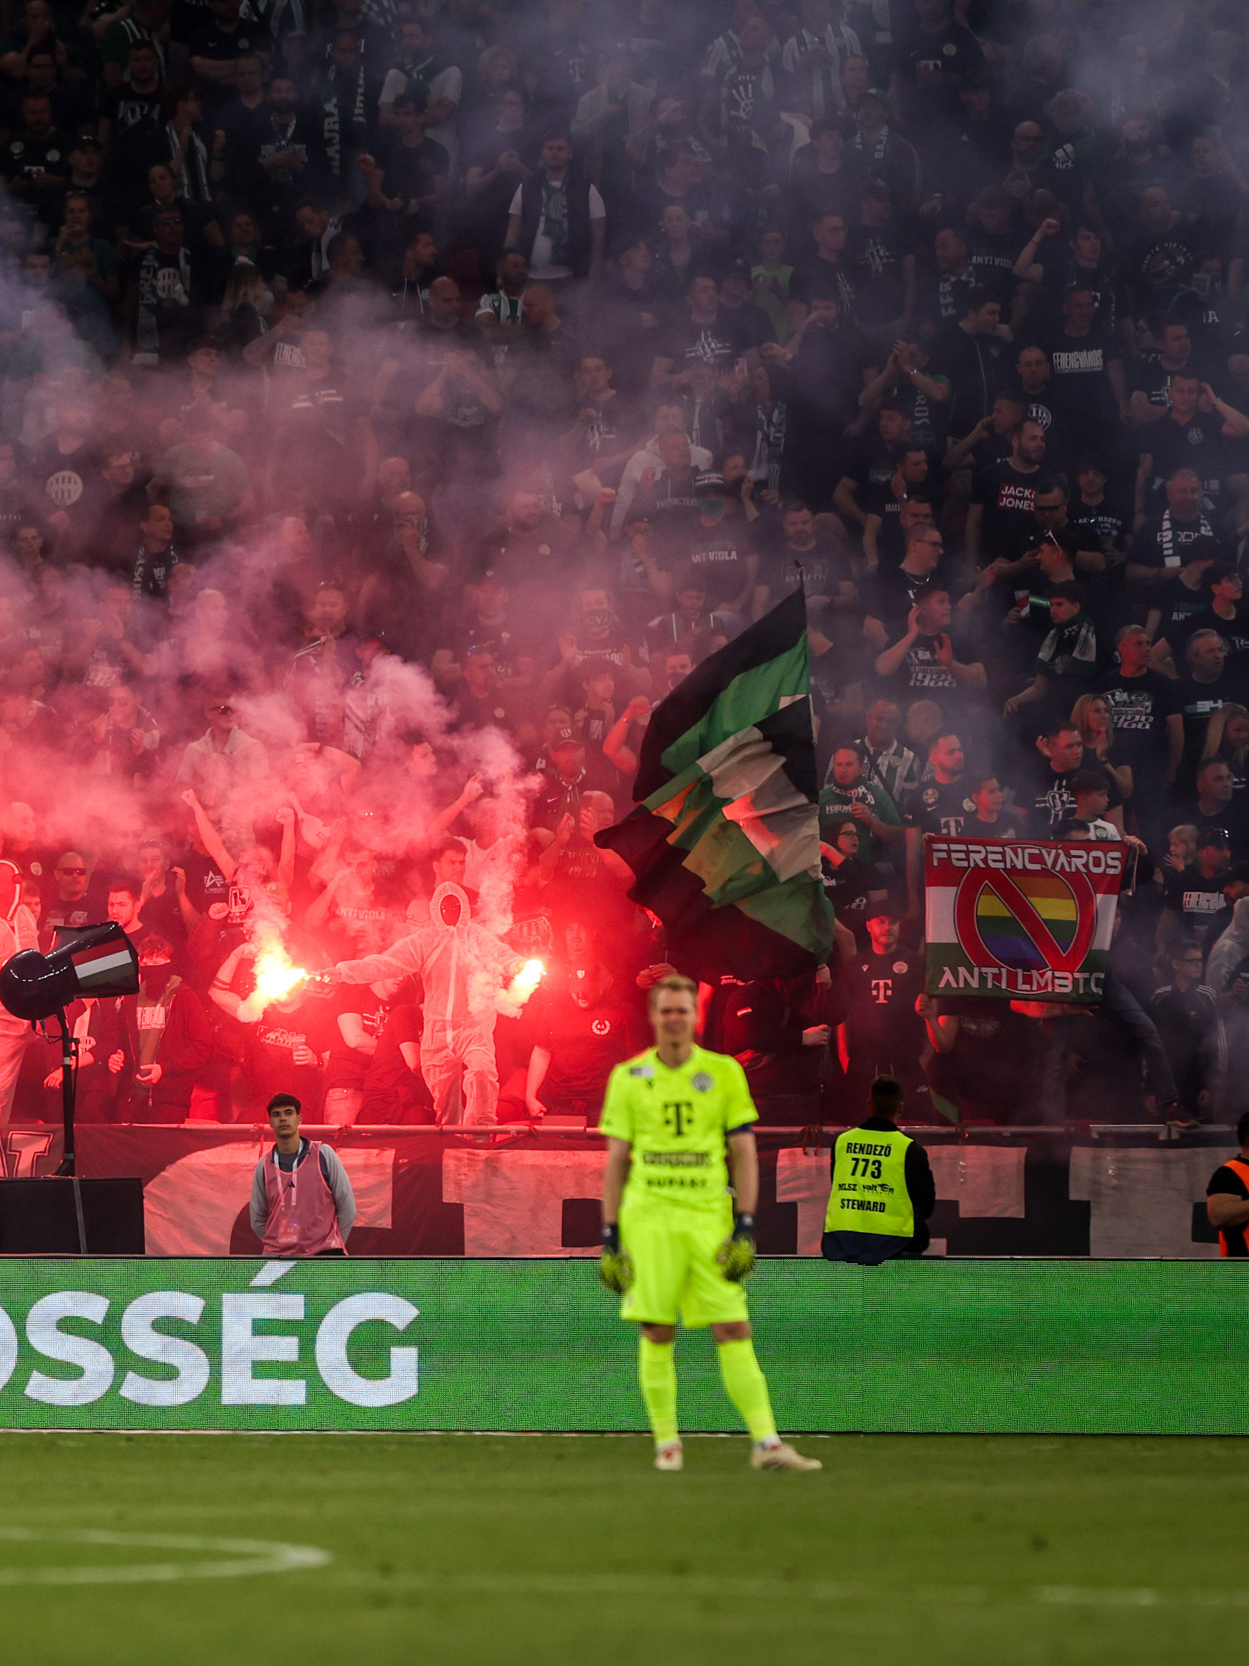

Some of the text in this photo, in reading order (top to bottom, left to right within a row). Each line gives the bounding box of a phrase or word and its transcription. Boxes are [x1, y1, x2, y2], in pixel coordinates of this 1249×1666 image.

[931, 843, 1122, 875] FERENCVÁROS
[938, 966, 1008, 990] ANTI
[871, 979, 893, 1004] T
[846, 1142, 892, 1157] RENDEZŐ
[851, 1157, 882, 1179] 773
[840, 1198, 886, 1213] STEWARD
